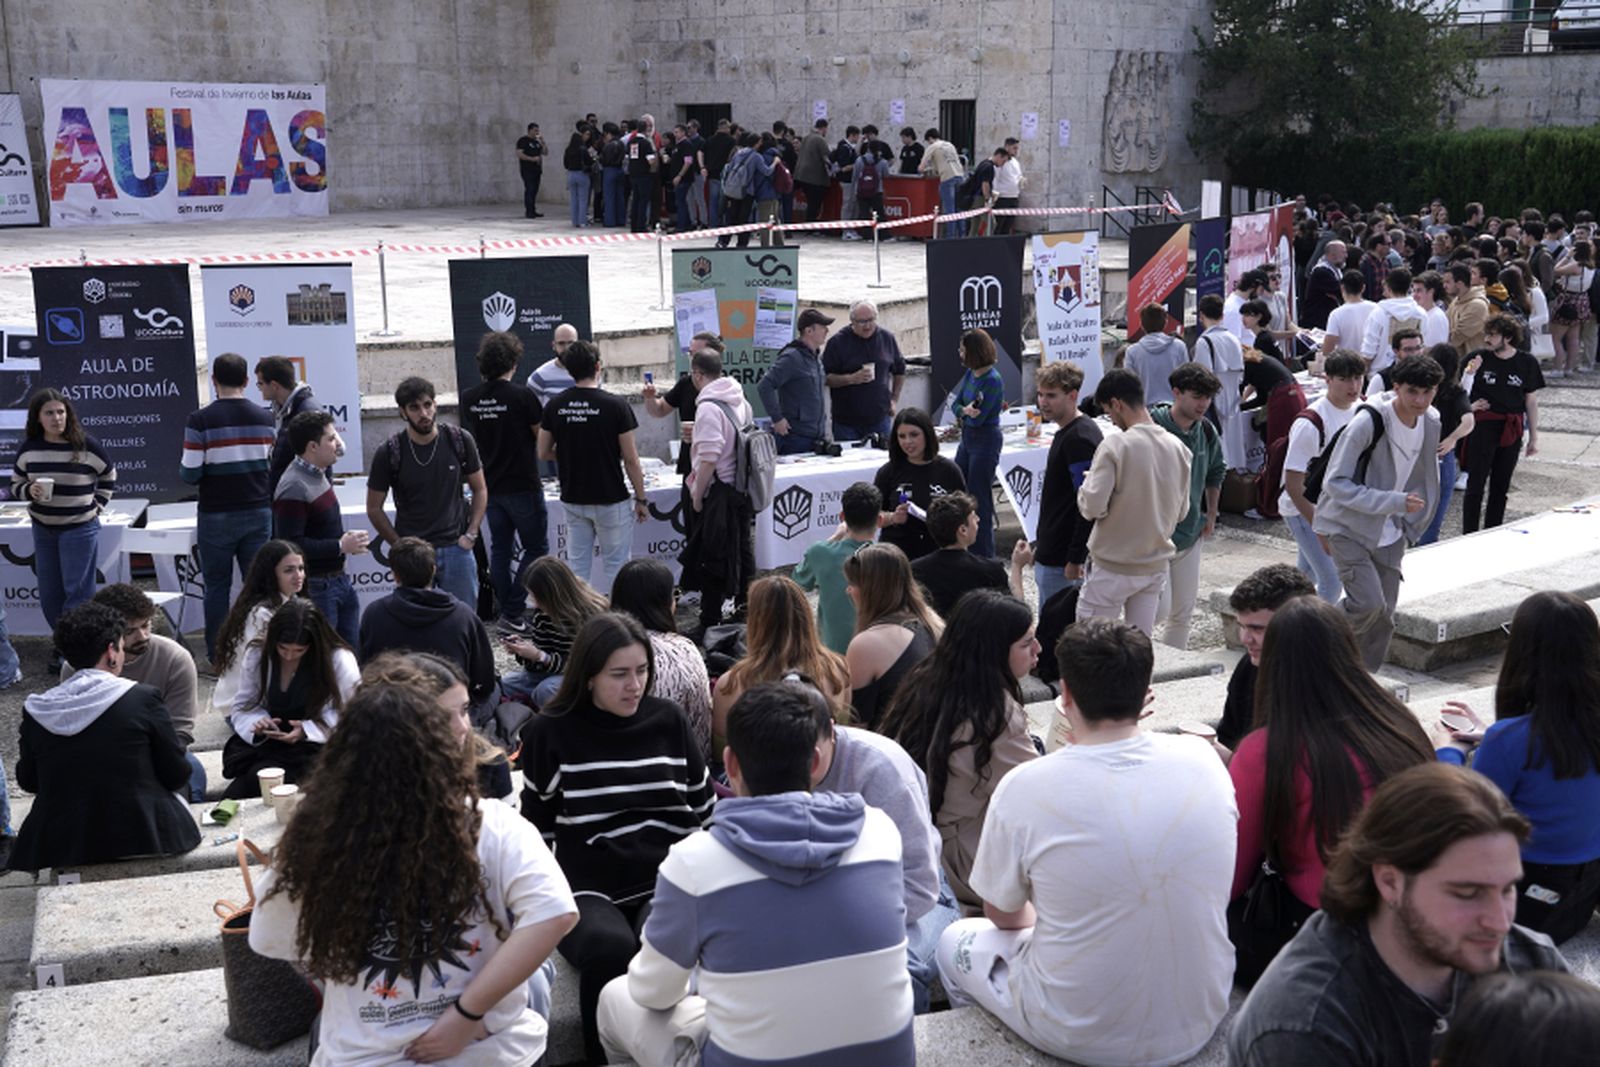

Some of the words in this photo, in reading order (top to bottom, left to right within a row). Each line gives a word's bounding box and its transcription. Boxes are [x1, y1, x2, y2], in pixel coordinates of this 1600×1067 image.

[170, 87, 205, 99] Festival
[258, 89, 269, 99] de
[272, 90, 285, 99] las
[287, 90, 312, 100] Aulas
[50, 107, 327, 201] AULAS
[178, 204, 192, 214] sin
[195, 203, 223, 213] muros
[960, 308, 1001, 321] GALERÍAS
[962, 319, 1000, 330] SALAZAR
[135, 328, 184, 336] UCOCultura
[753, 350, 771, 363] DE
[80, 358, 127, 374] AULA
[132, 357, 154, 372] DE
[60, 378, 180, 400] ASTRONOMÍA
[81, 414, 161, 426] OBSERVACIONES
[101, 437, 146, 448] TALLERES
[112, 460, 147, 470] ARLAS
[46, 974, 56, 987] 4
